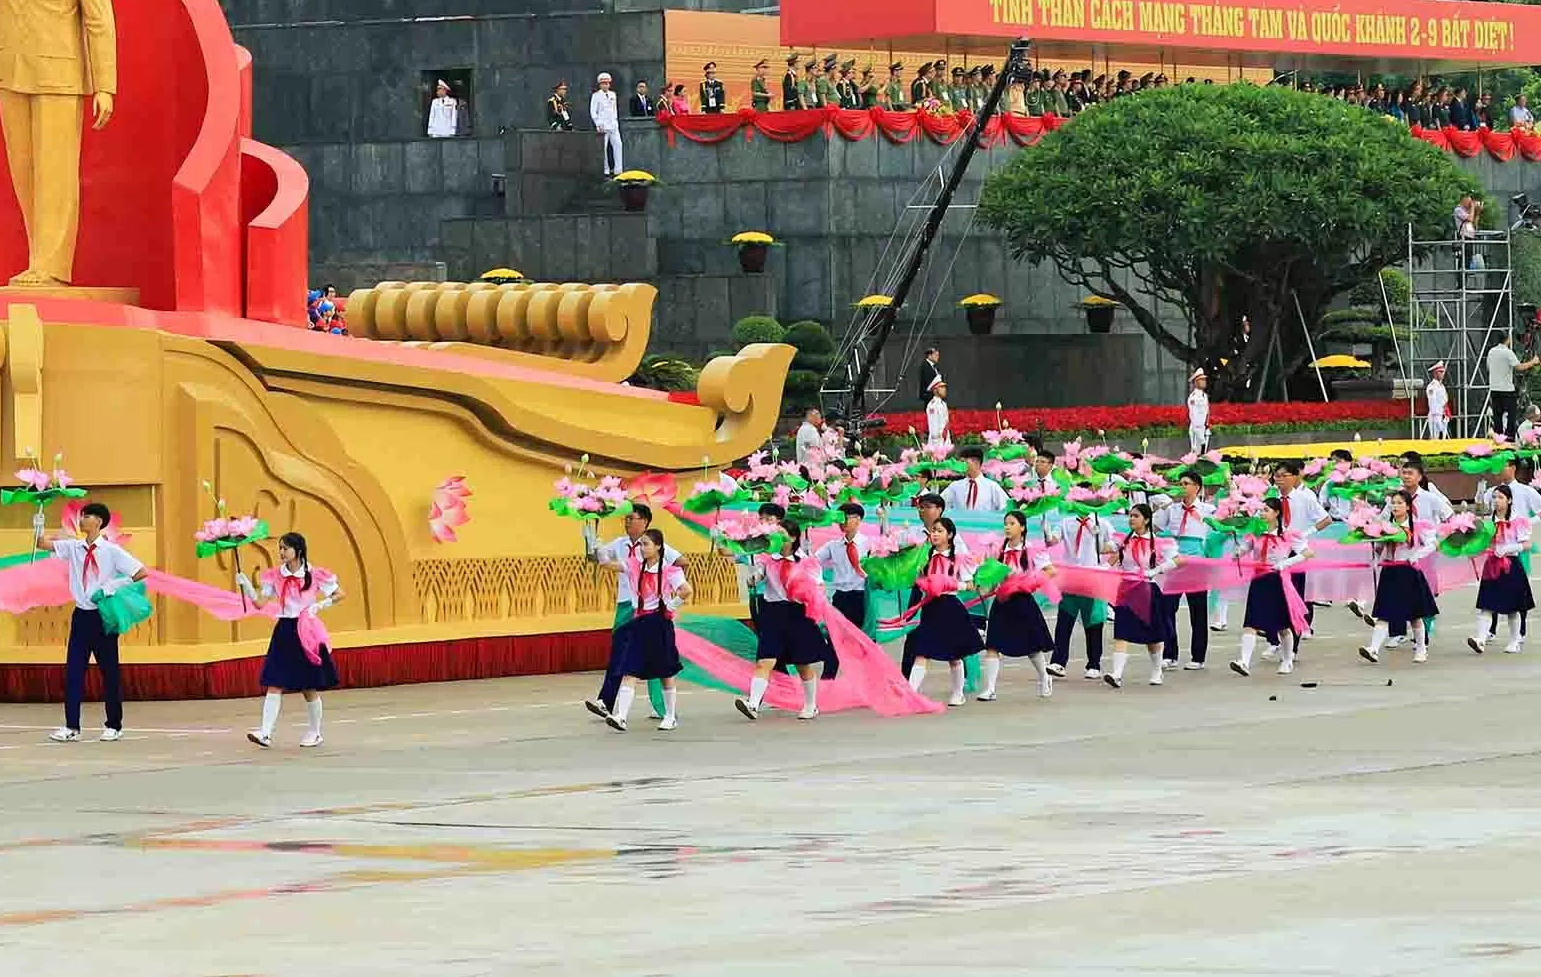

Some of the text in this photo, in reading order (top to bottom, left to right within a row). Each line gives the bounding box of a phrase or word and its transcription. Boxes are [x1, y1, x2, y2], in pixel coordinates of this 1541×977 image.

[1139, 0, 1186, 38] MẠNG
[1248, 1, 1283, 39] TÁM
[1286, 4, 1308, 40] VÀ
[1310, 4, 1351, 44] QUỐC
[1355, 7, 1406, 45] KHÁNH
[1410, 16, 1437, 46] 2-9
[1441, 10, 1469, 48] BẤT
